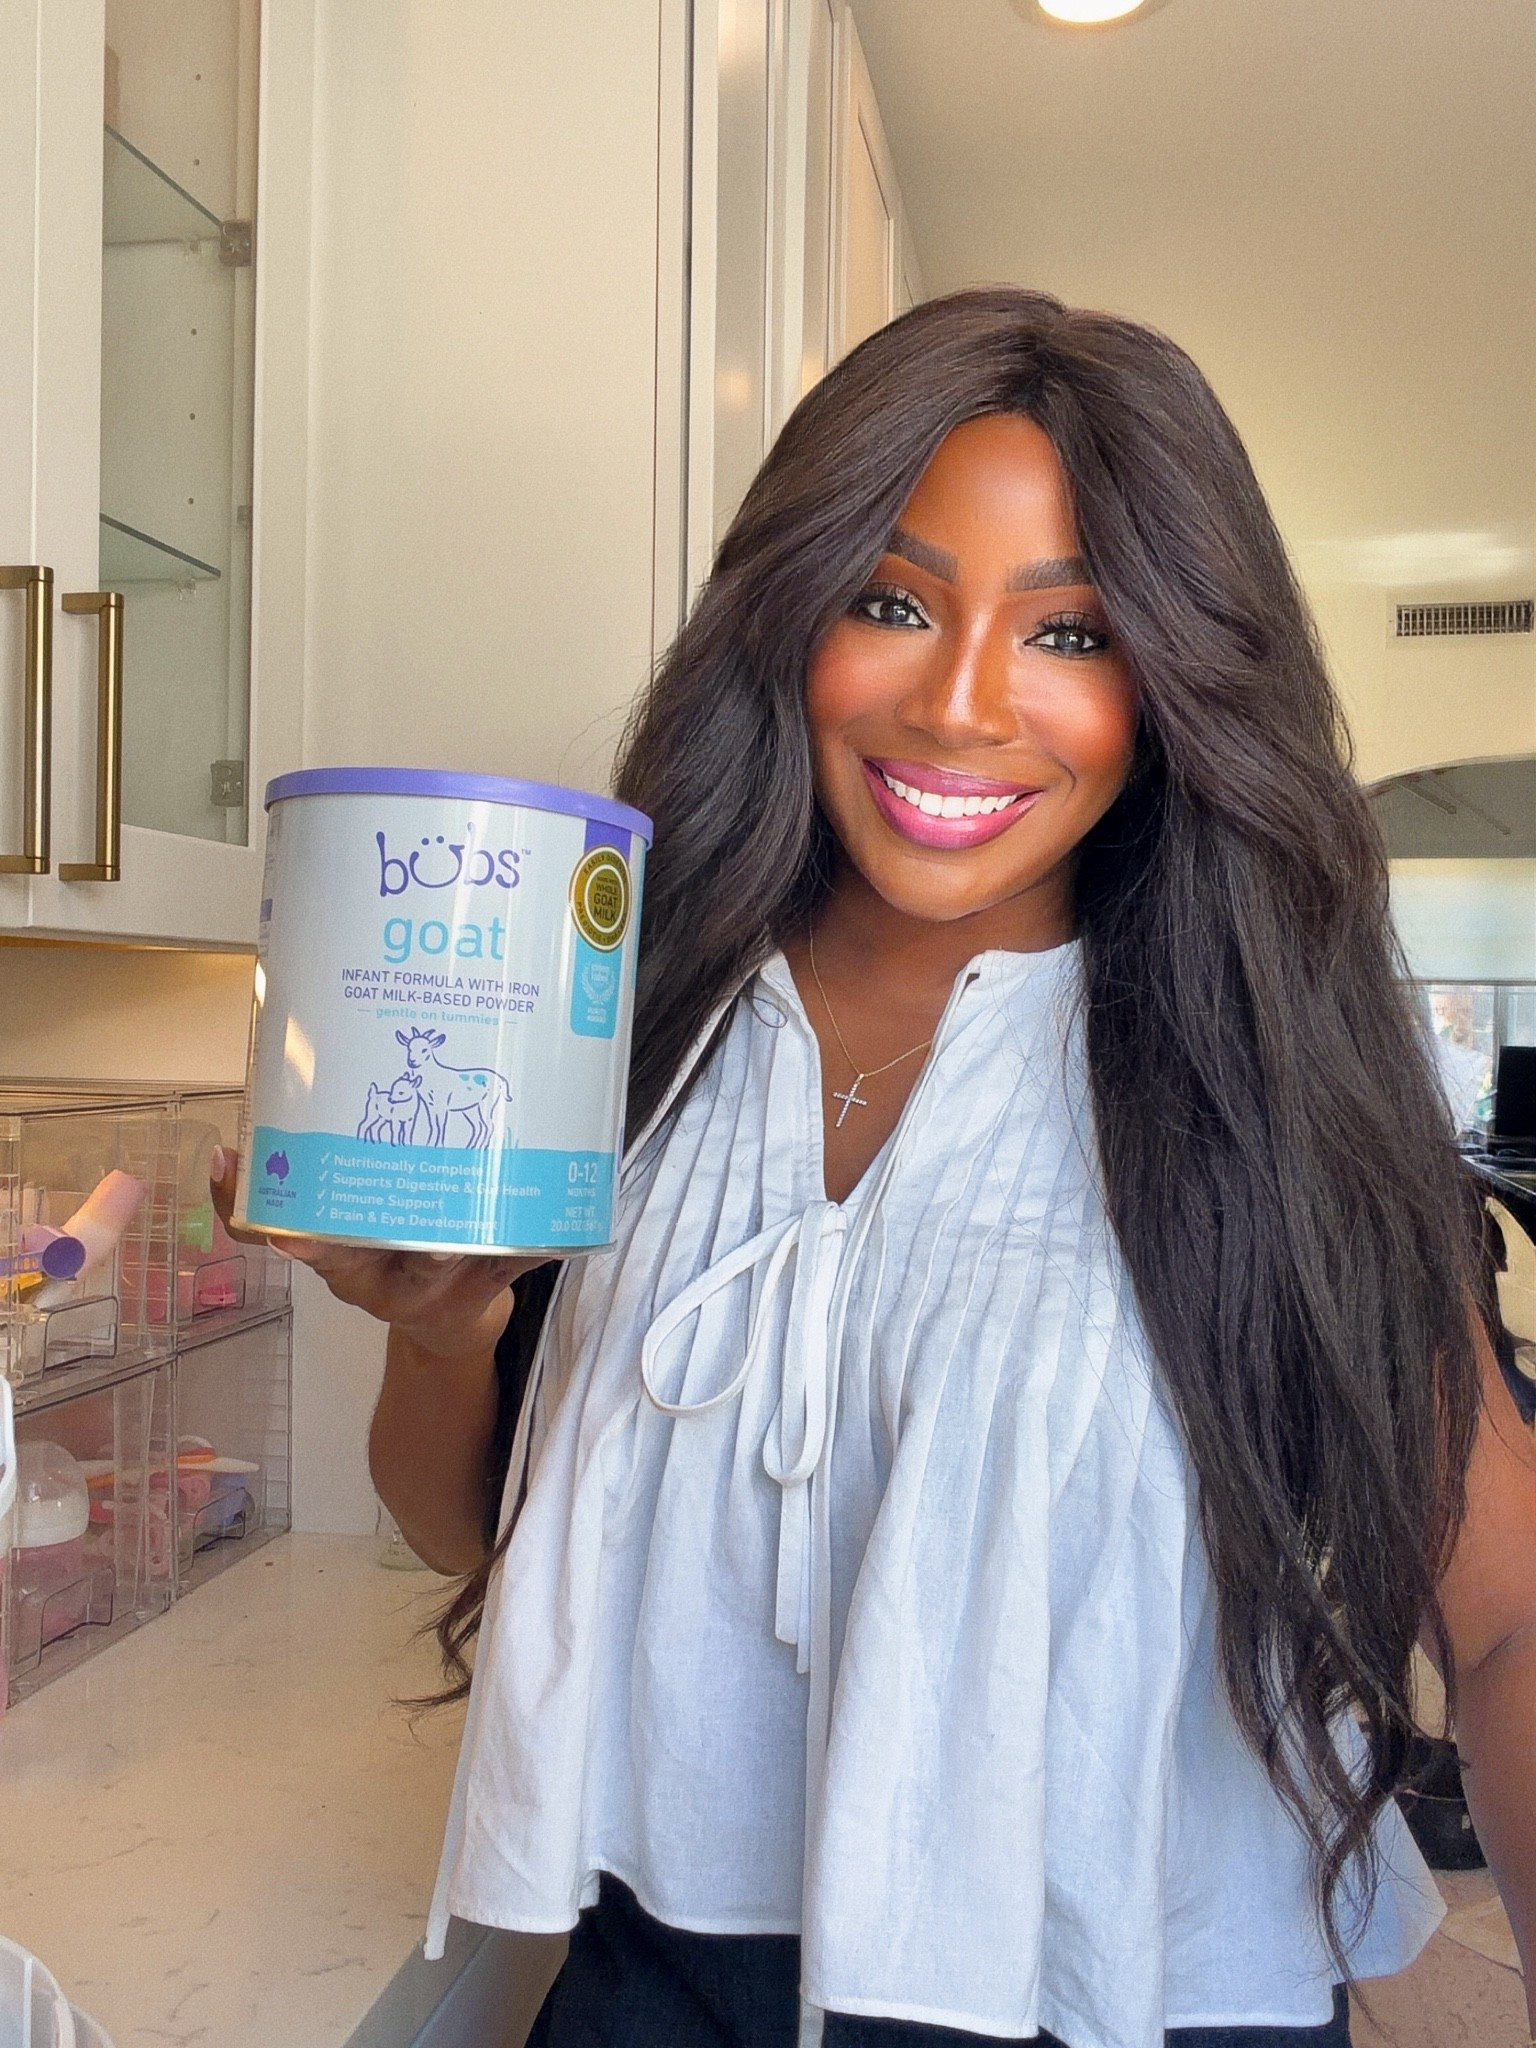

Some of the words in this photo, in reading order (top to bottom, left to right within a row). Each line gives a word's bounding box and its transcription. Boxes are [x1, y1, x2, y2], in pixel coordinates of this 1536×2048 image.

[594, 893, 618, 908] GOAT
[594, 906, 616, 922] MILK
[384, 916, 506, 964] goat
[341, 968, 390, 983] INFANT
[393, 972, 464, 989] FORMULA
[468, 978, 504, 993] WITH
[508, 982, 540, 997] IRON
[344, 986, 378, 1000] GOAT
[382, 988, 471, 1007] MILK-BASED
[476, 996, 534, 1013] POWDER
[376, 1006, 416, 1019] gentle
[421, 1011, 437, 1020] on
[441, 1011, 499, 1026] tummies
[334, 1154, 415, 1174] Nutritionally
[419, 1161, 484, 1177] Complete
[568, 1161, 598, 1184] 0-12
[332, 1172, 392, 1188] Supports
[396, 1177, 459, 1193] Digestive
[463, 1181, 472, 1194] &
[503, 1184, 541, 1197] Health
[331, 1190, 384, 1206] Immune
[388, 1194, 445, 1210] Support
[329, 1207, 364, 1222] Brain
[367, 1211, 377, 1223] &
[381, 1211, 405, 1227] Eye
